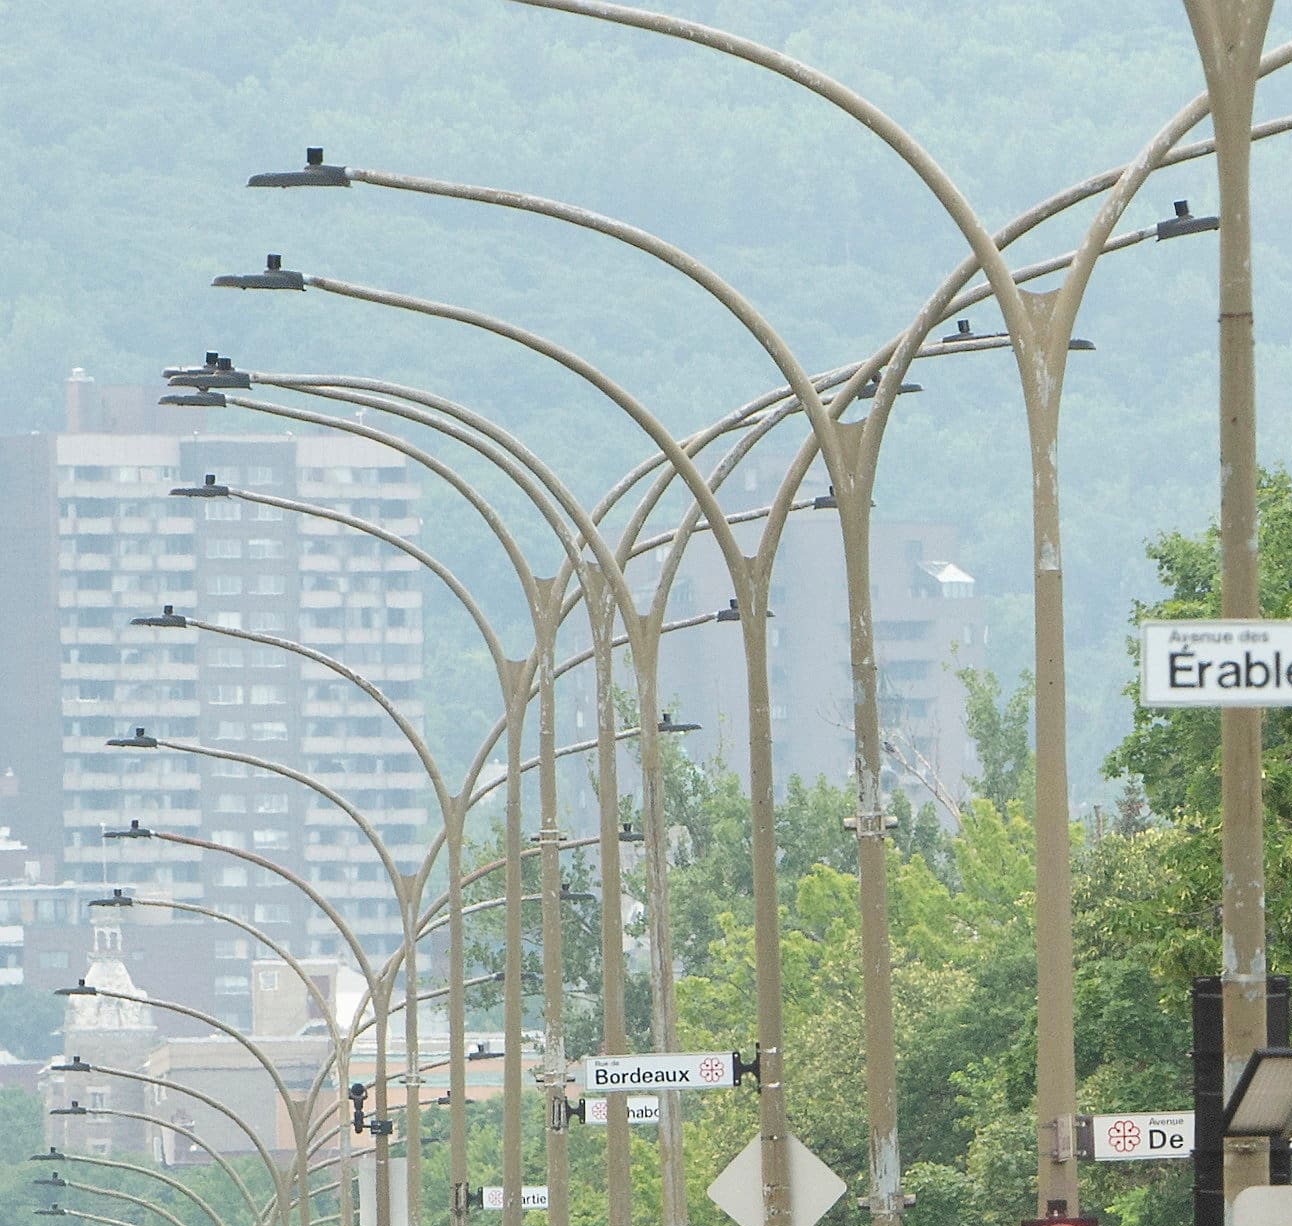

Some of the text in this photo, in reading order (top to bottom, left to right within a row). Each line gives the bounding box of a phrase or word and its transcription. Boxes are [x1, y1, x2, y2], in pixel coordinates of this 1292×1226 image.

[1169, 628, 1270, 643] Avenue des
[595, 1067, 690, 1085] Bordeaux
[627, 1105, 660, 1118] habo
[1149, 1117, 1184, 1126] Avenue
[1149, 1130, 1184, 1149] De
